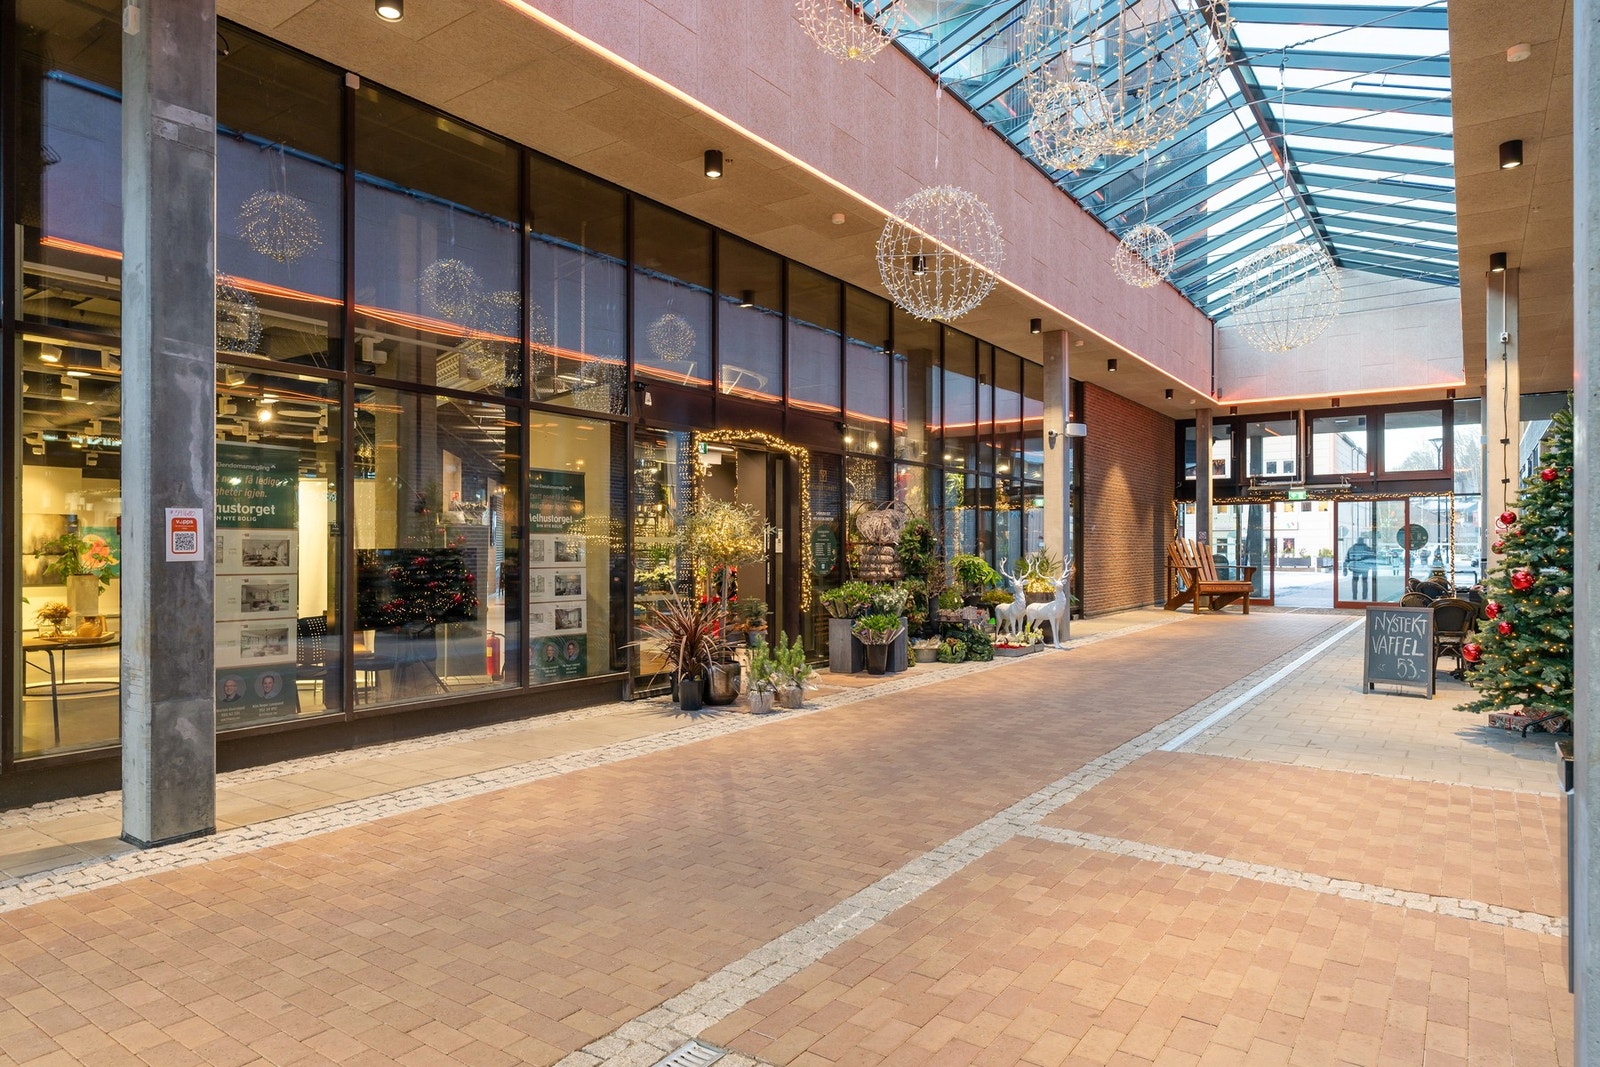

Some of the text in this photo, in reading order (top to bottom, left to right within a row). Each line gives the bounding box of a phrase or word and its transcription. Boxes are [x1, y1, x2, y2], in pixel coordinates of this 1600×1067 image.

[245, 475, 254, 485] få
[216, 502, 276, 517] hustorget
[529, 513, 573, 525] elhustorget
[1374, 612, 1428, 639] NYSTEKT
[1372, 634, 1425, 657] VAFFEL
